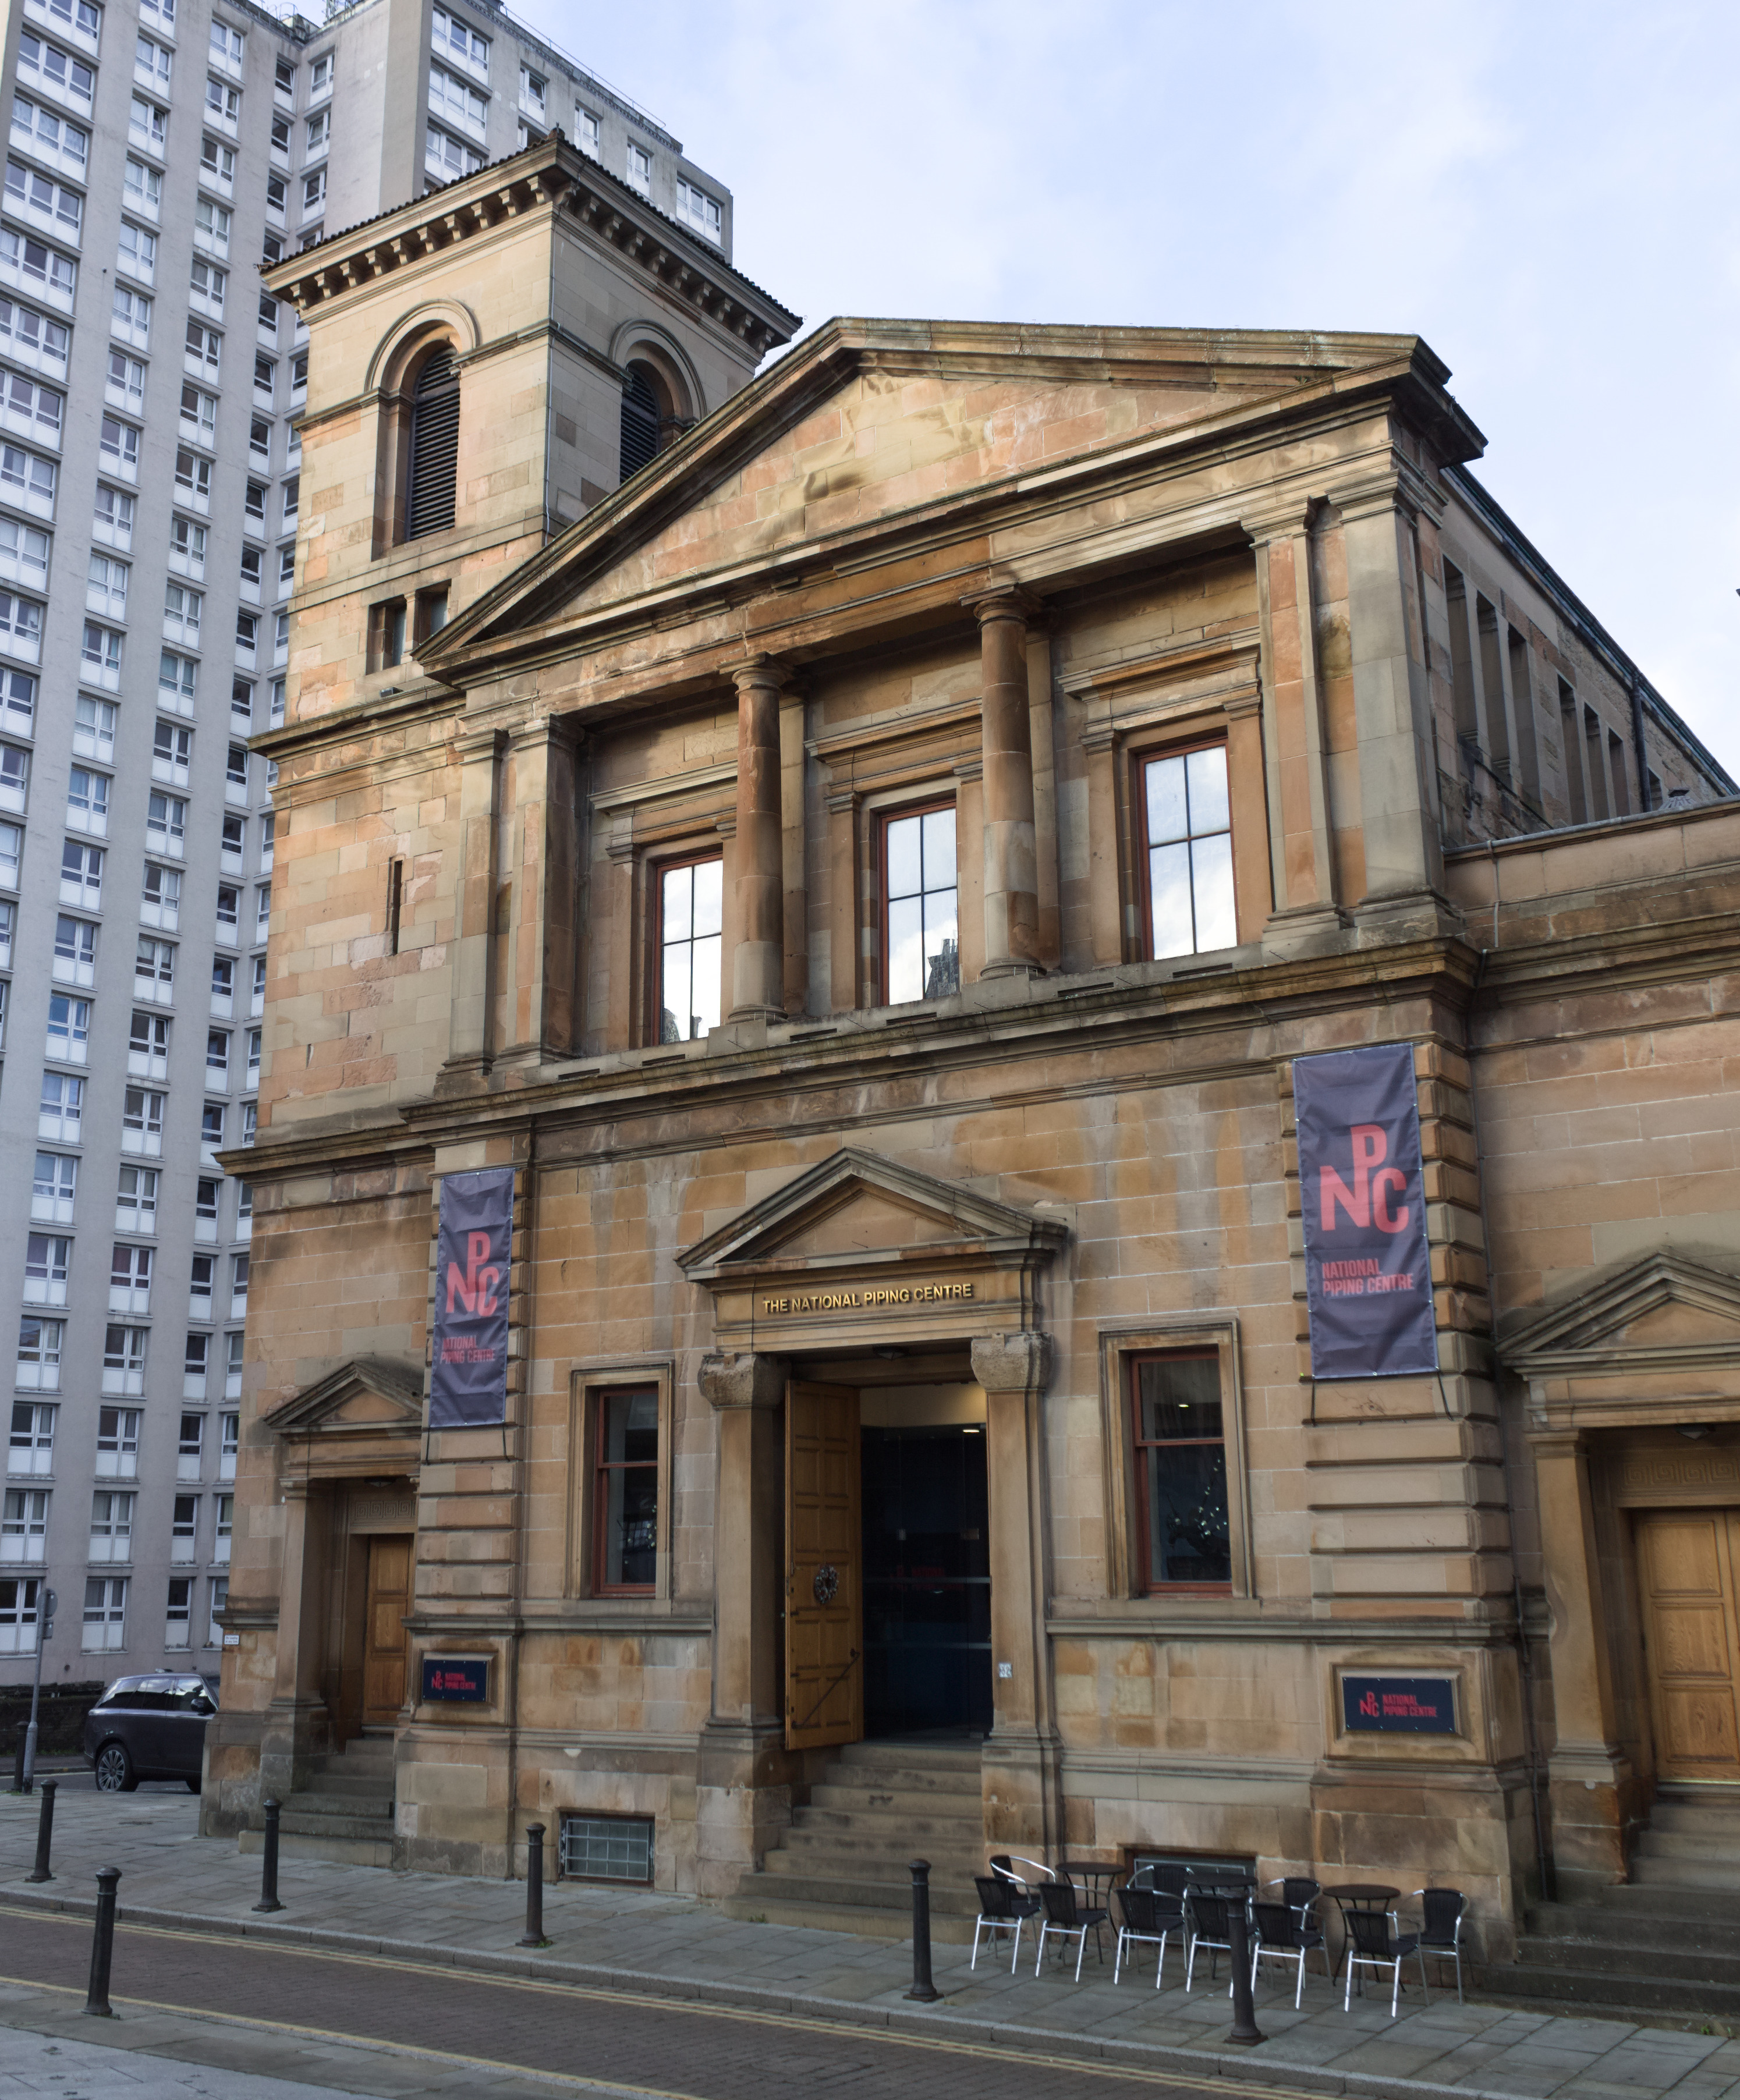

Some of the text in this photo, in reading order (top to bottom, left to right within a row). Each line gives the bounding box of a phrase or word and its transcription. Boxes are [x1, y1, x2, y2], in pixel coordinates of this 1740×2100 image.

[1322, 1258, 1383, 1279] NATIONAL
[1323, 1273, 1415, 1297] PIPING CENTRE
[764, 1283, 972, 1313] THE NATIONAL PIPING CENTRE
[442, 1335, 479, 1351] NATIONAL
[440, 1348, 496, 1364] PIPING CENTRE
[1383, 1694, 1417, 1705] NATIONAL
